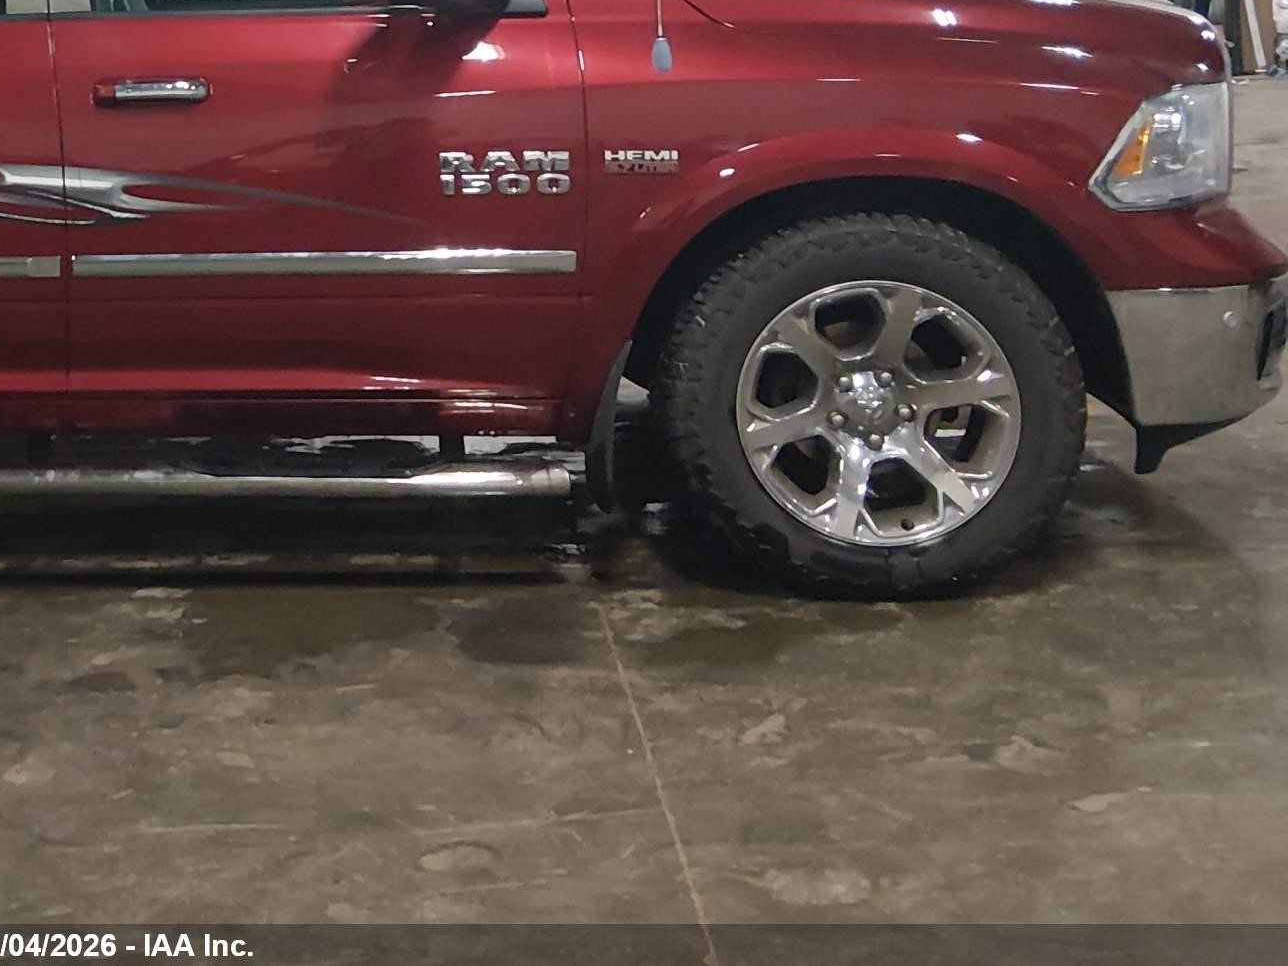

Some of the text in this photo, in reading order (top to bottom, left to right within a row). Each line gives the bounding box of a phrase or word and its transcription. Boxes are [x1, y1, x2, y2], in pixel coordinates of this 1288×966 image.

[439, 151, 571, 173] RAM
[604, 150, 679, 161] HEMI
[439, 173, 571, 195] 1500
